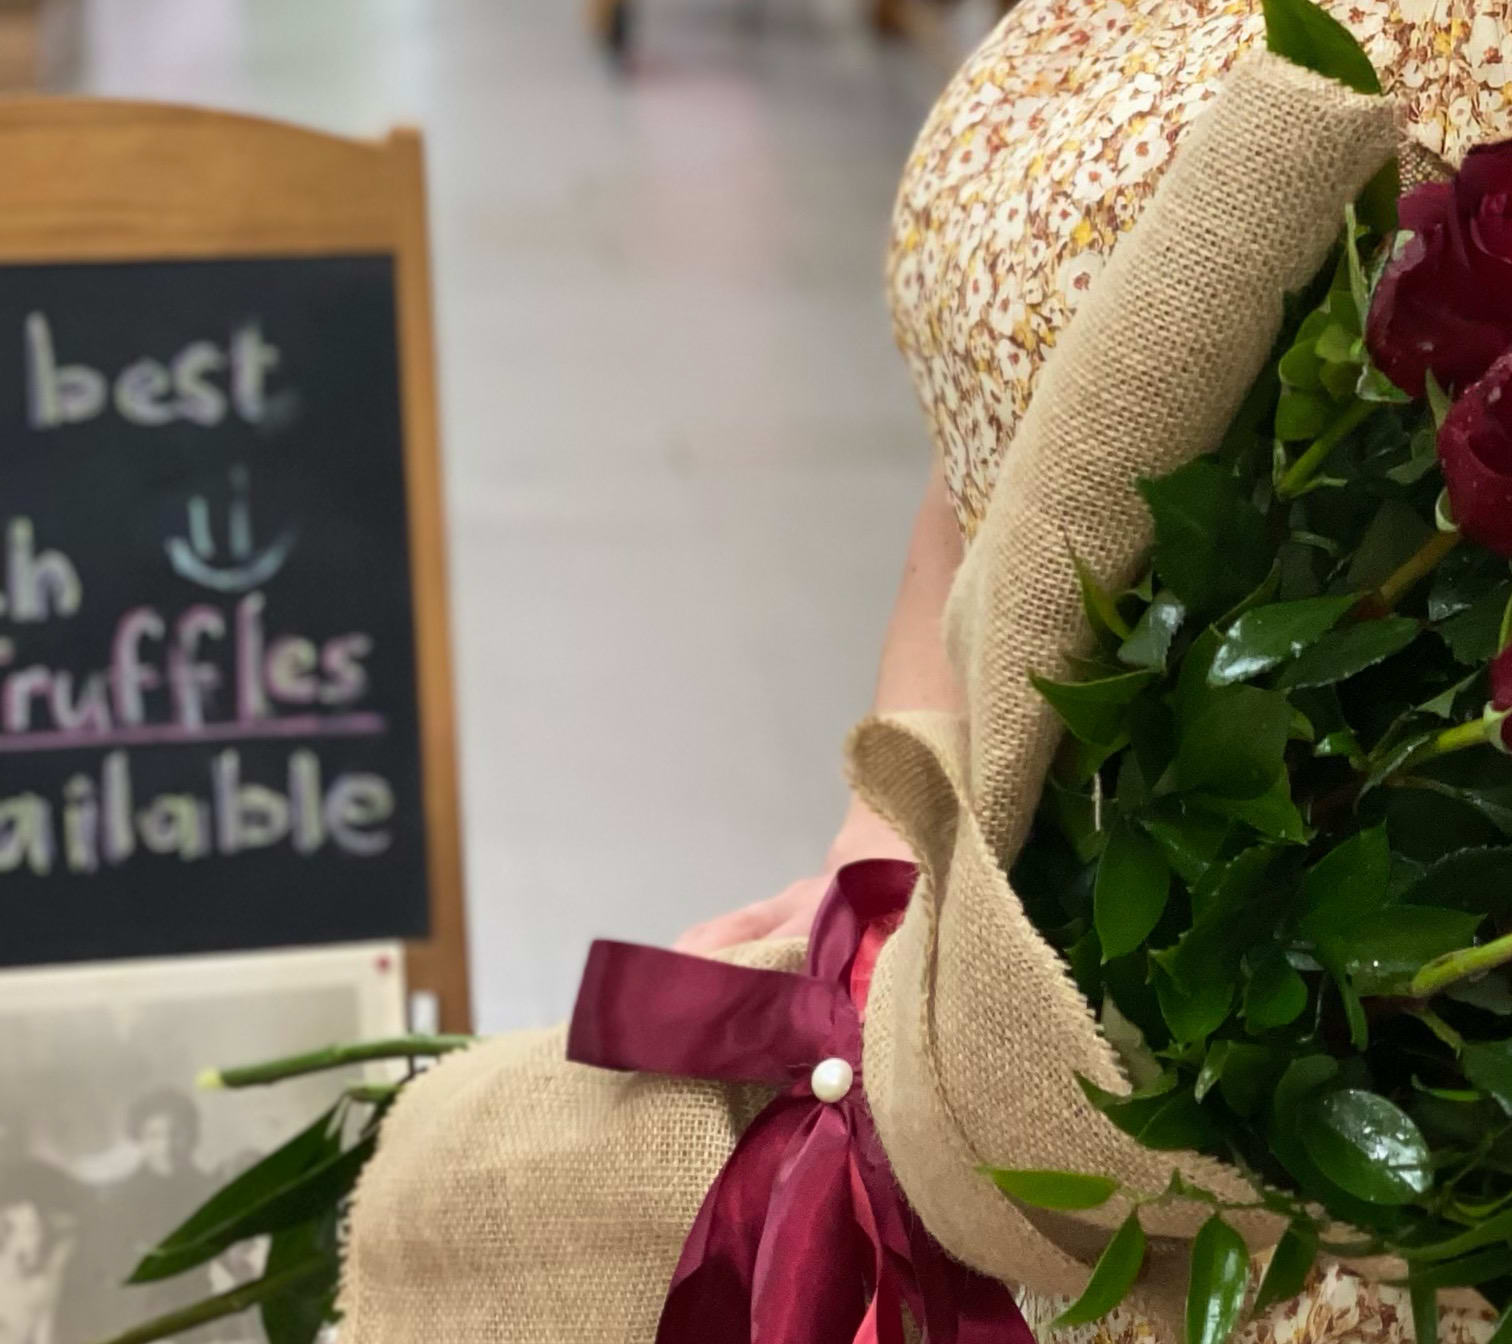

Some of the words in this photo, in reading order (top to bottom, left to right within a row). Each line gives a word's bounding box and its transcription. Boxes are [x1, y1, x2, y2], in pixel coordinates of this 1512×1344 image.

[26, 310, 284, 430] best
[0, 516, 83, 623] h
[0, 592, 374, 734] ruffles
